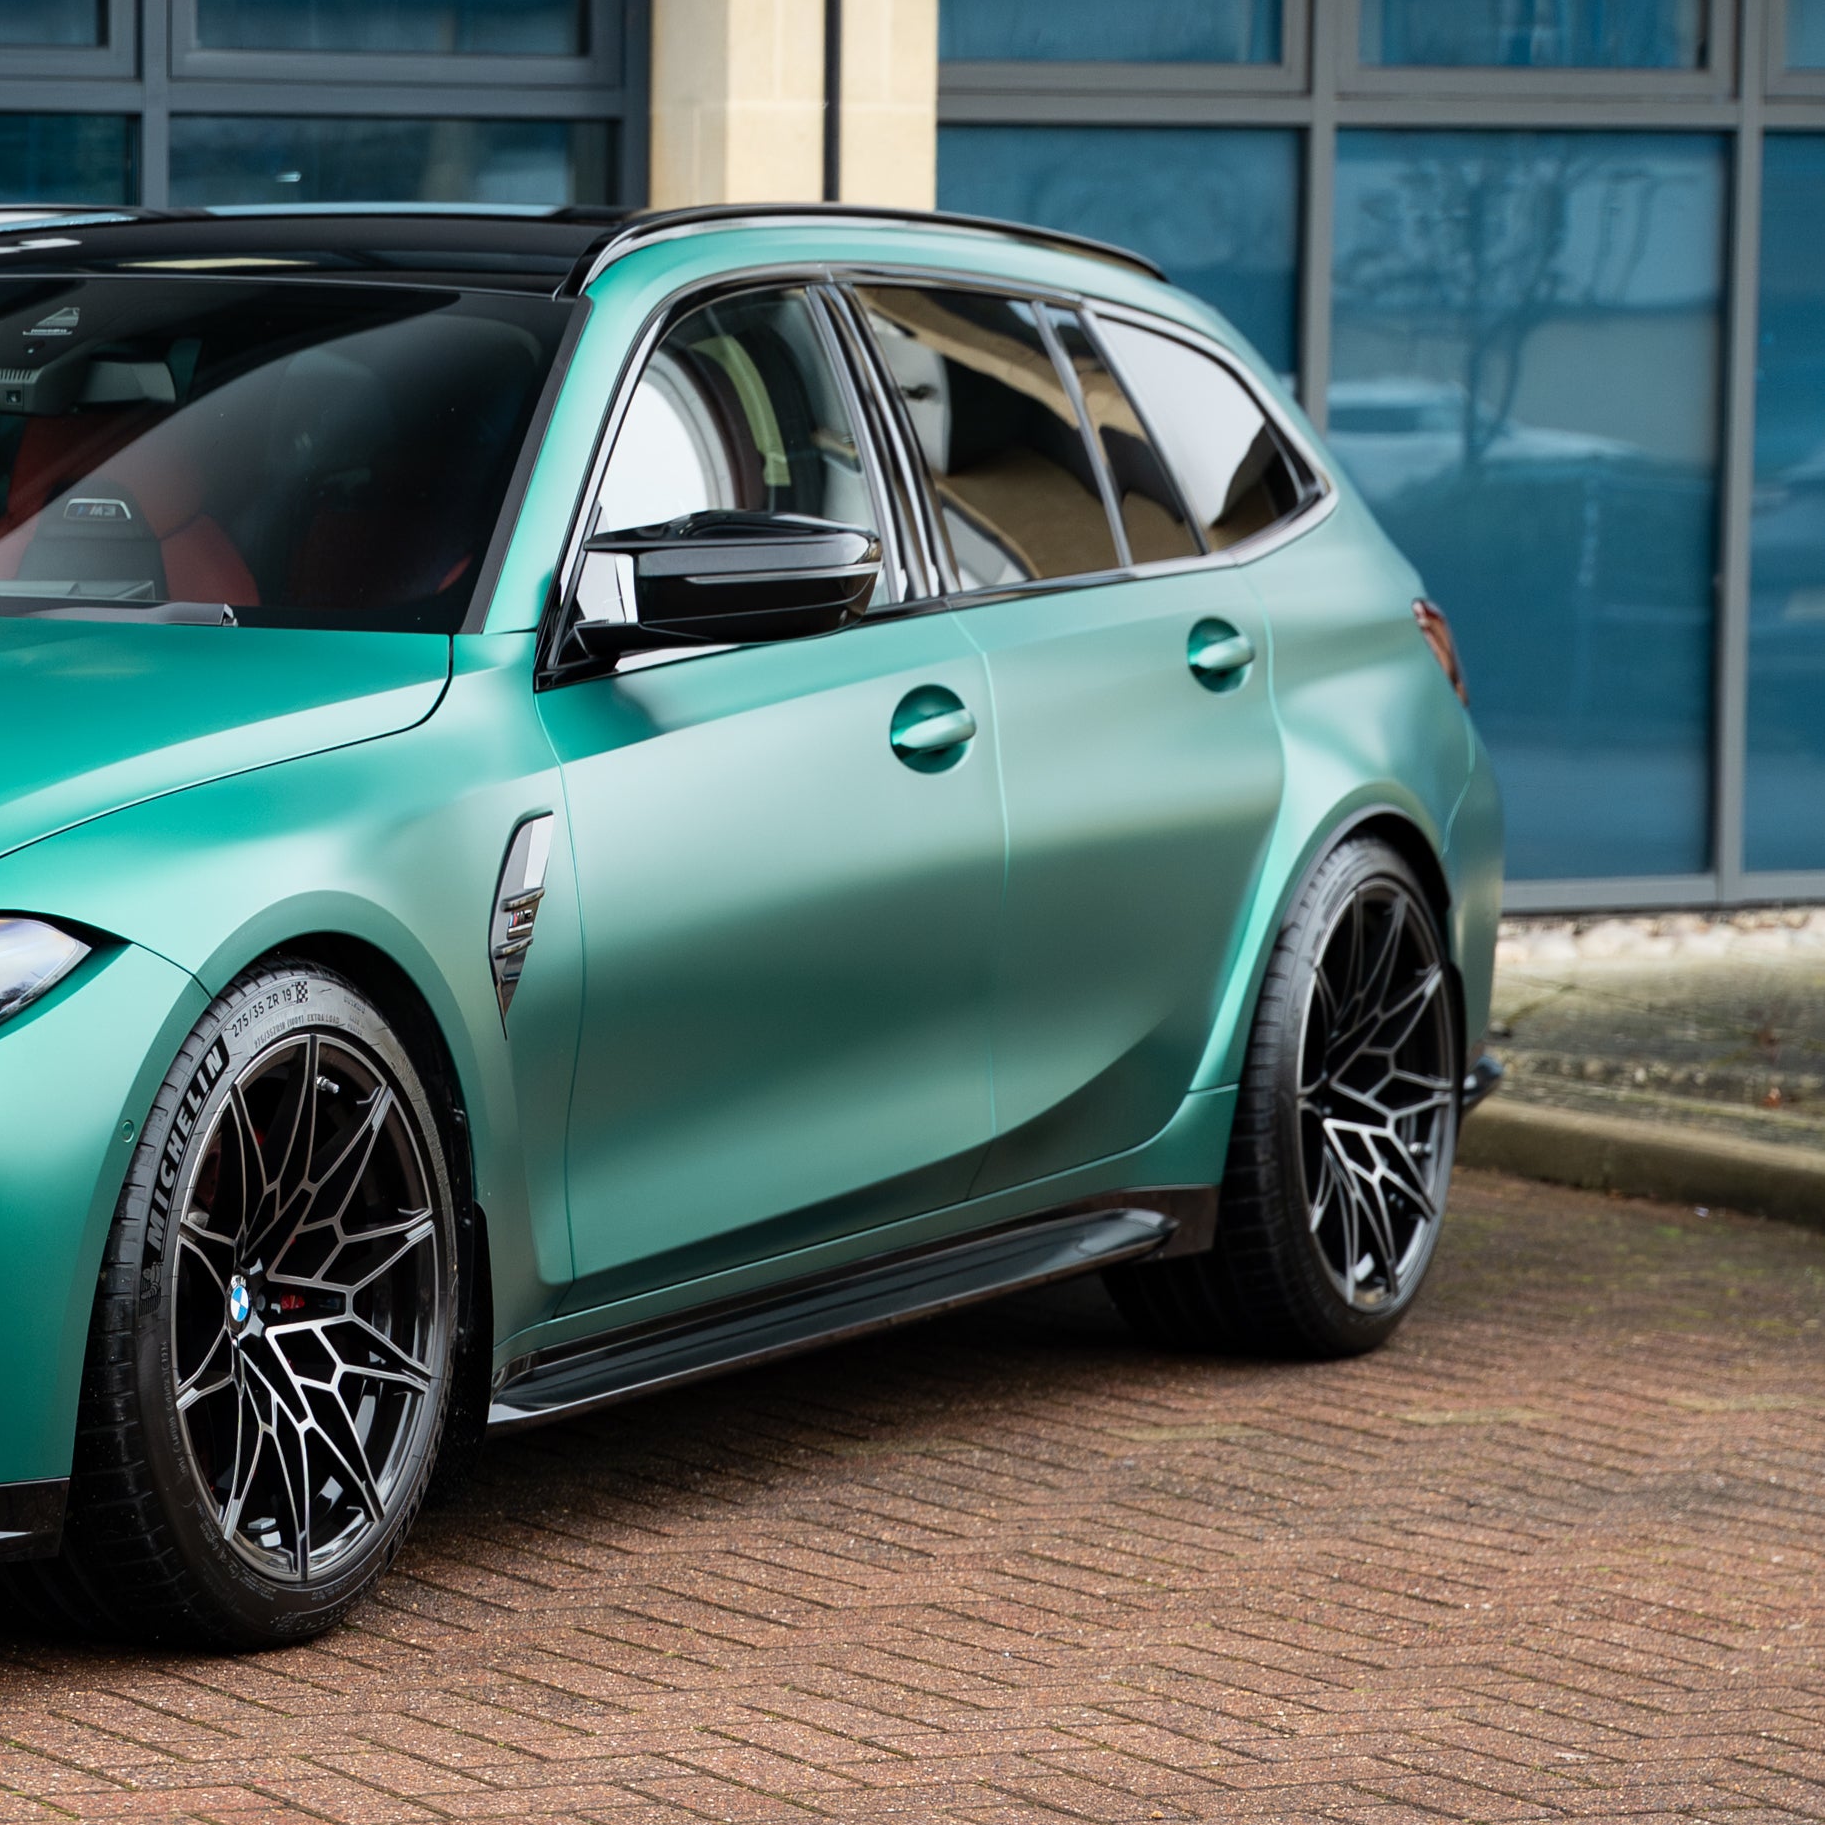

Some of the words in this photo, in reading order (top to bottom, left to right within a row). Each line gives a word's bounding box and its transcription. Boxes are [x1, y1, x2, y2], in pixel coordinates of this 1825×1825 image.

[231, 1001, 265, 1038] 275/35
[266, 993, 280, 1010] ZR
[282, 987, 292, 1002] 19
[145, 1043, 225, 1254] MICHELIN
